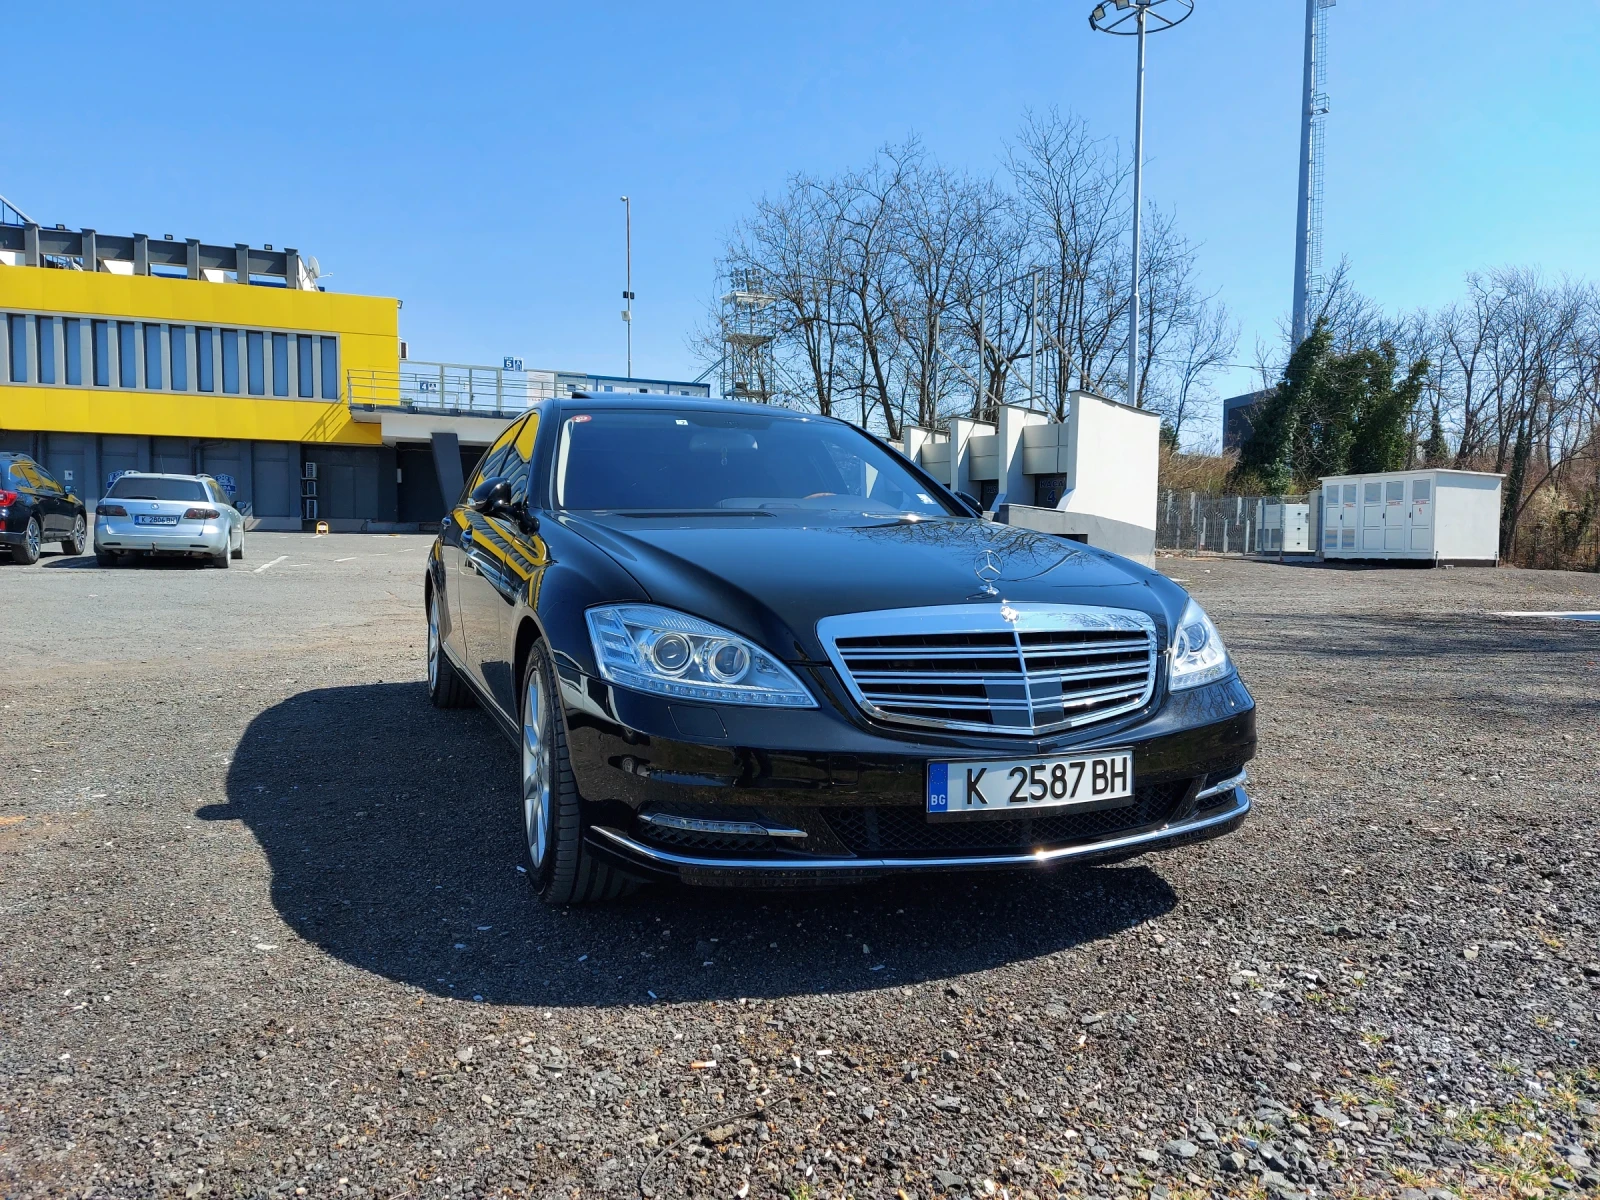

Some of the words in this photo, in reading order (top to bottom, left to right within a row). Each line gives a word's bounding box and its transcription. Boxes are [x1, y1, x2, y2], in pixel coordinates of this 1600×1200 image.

[506, 360, 512, 368] 5
[1039, 479, 1064, 489] КАСА
[1047, 489, 1056, 503] 4
[966, 768, 988, 805] K
[1009, 761, 1086, 803] 2587
[1092, 757, 1128, 796] BH
[931, 794, 946, 806] BG
